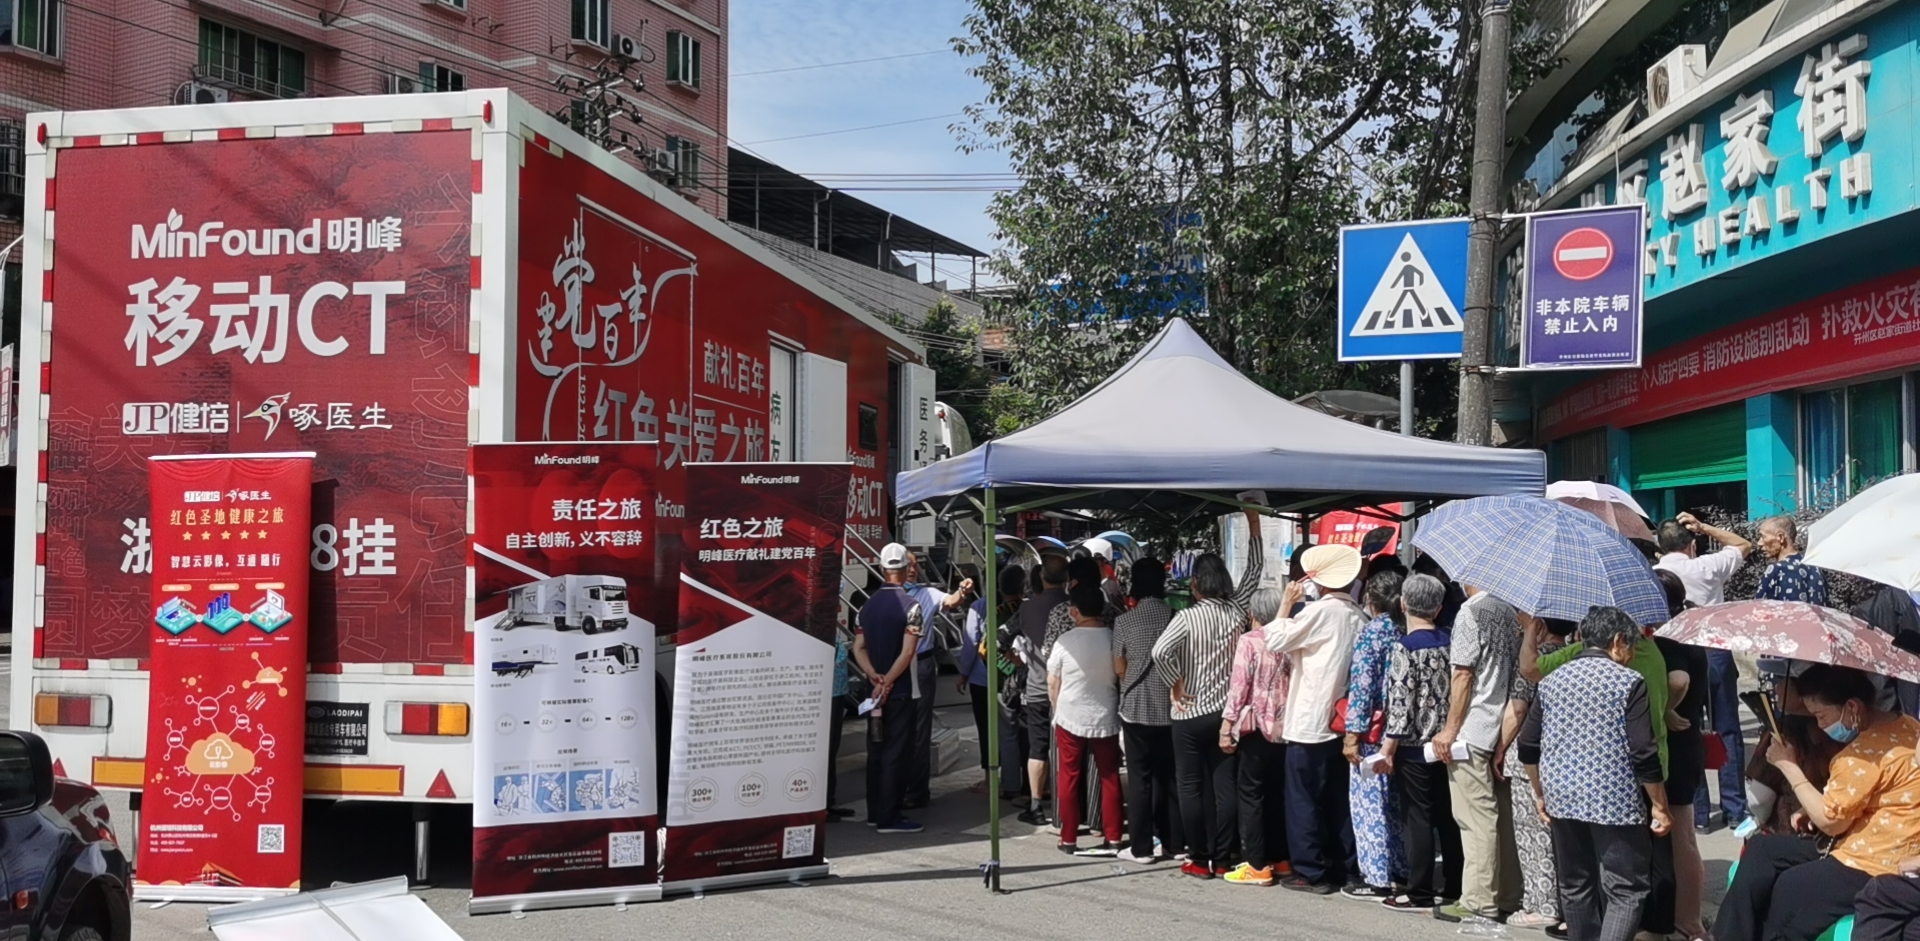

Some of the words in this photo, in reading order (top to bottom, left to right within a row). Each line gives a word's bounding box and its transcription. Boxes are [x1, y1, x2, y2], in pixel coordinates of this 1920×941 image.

[1694, 153, 1873, 257] HEALTH
[1536, 294, 1630, 316] 非本院车辆
[124, 275, 406, 368] 移动CT
[1544, 315, 1618, 335] 禁止入内
[1703, 313, 1810, 373] 消防设施别乱动
[703, 339, 766, 399] 献礼百年
[289, 402, 393, 431] 啄医生
[593, 379, 766, 471] 红色关爱之旅
[170, 507, 284, 526] 红色圣地健康之旅
[552, 498, 642, 521] 责任之旅
[700, 517, 784, 539] 红色之旅
[698, 546, 816, 562] 明峰医疗献礼建党百年
[692, 788, 712, 797] 300+
[741, 783, 761, 792] 100+
